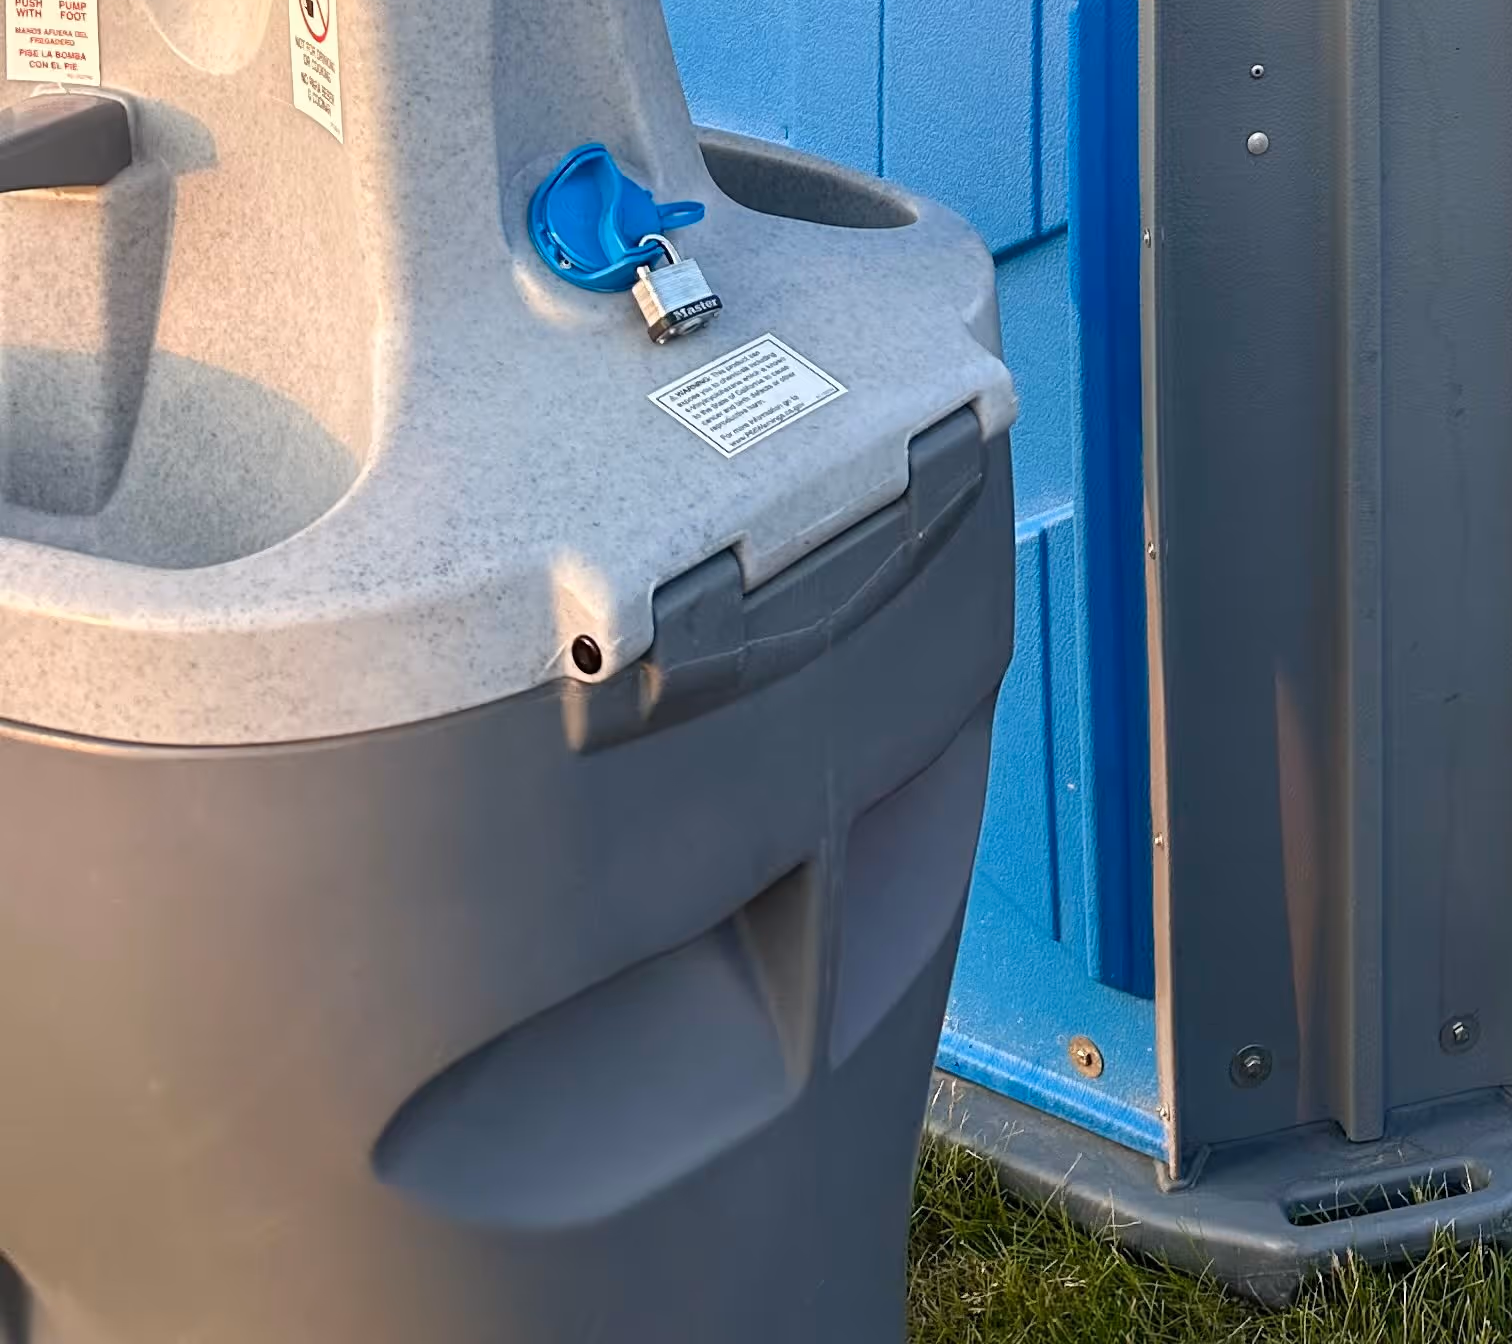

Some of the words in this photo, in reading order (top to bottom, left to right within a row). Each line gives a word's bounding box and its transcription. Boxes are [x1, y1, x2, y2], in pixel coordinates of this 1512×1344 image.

[59, 0, 87, 11] PUMP
[16, 8, 42, 18] WITH
[60, 11, 87, 21] FOOT
[19, 49, 39, 58] PISE
[41, 50, 53, 58] LA
[55, 51, 86, 61] BOMBA
[29, 60, 48, 69] CON
[51, 61, 61, 69] EL
[672, 298, 719, 321] Master
[675, 377, 711, 397] WARNING:
[711, 369, 725, 378] This
[724, 357, 749, 371] product
